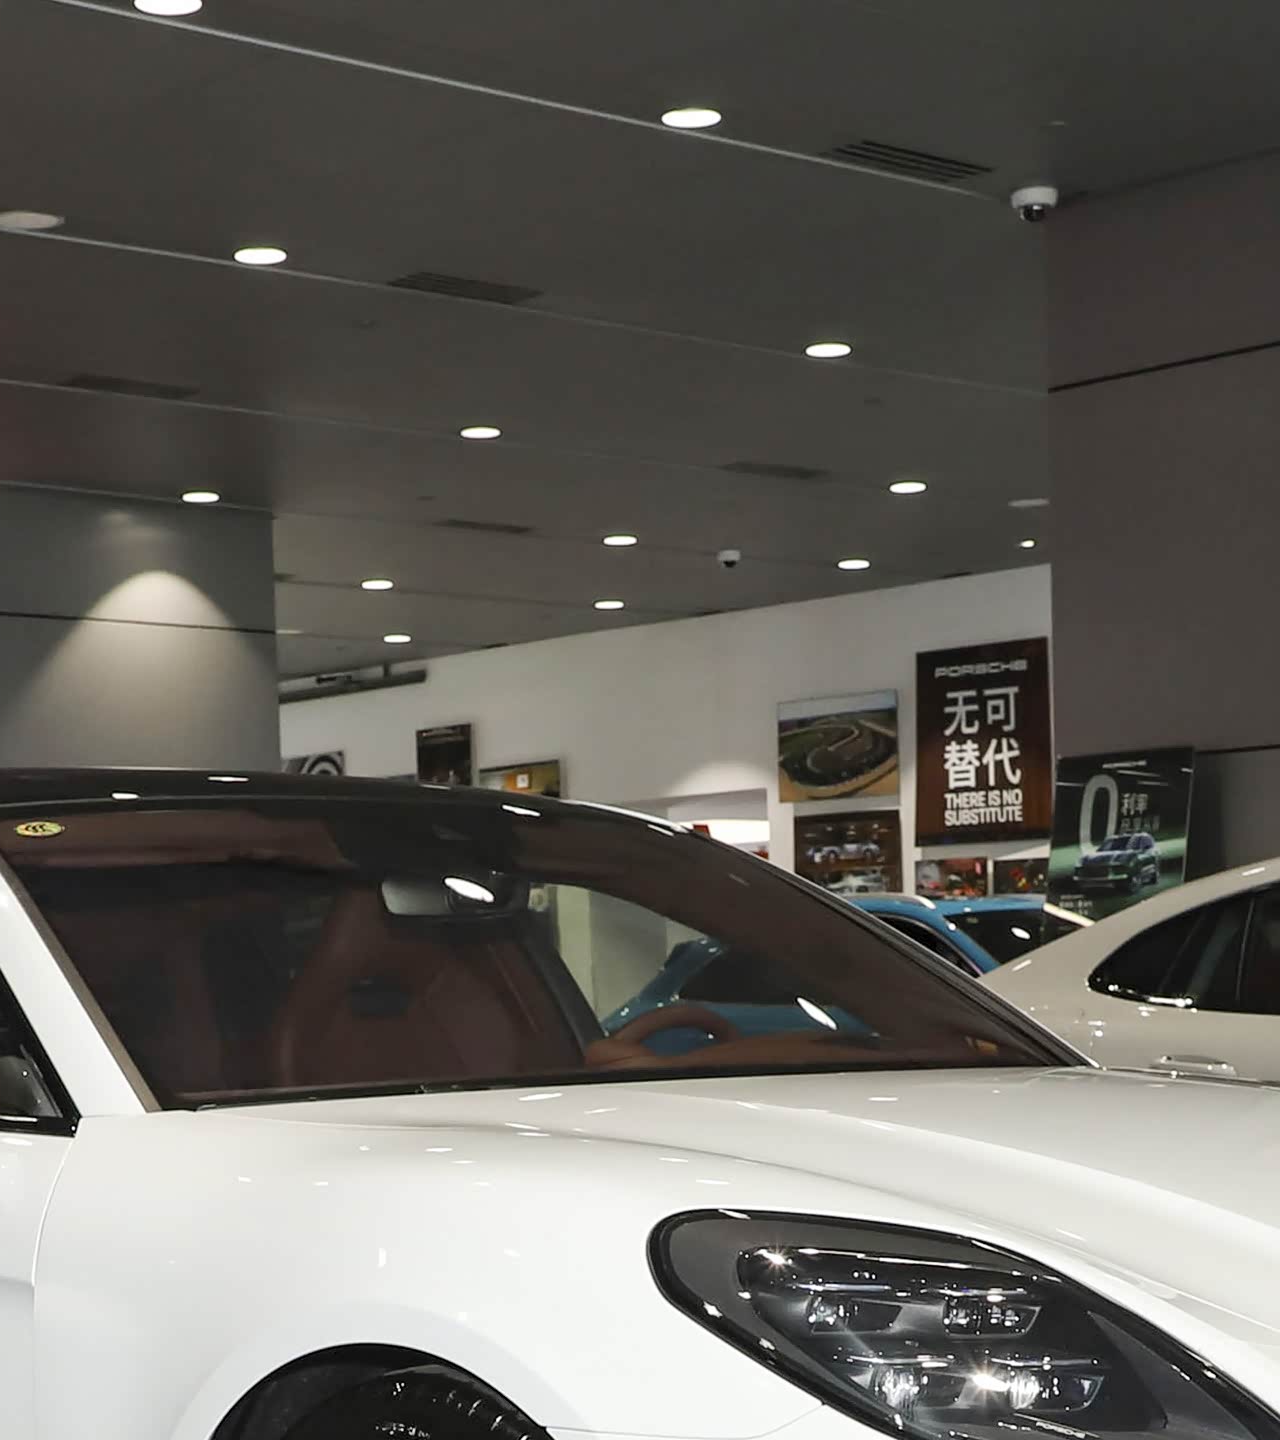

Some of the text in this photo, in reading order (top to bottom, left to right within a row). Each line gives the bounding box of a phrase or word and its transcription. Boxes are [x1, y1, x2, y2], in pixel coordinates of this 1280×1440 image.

[934, 659, 1028, 678] PORSCHE
[943, 686, 1019, 736] 无可
[943, 737, 1022, 789] 替代
[944, 788, 1023, 809] THERE IS NO
[944, 805, 1023, 827] SUBSTITUTE
